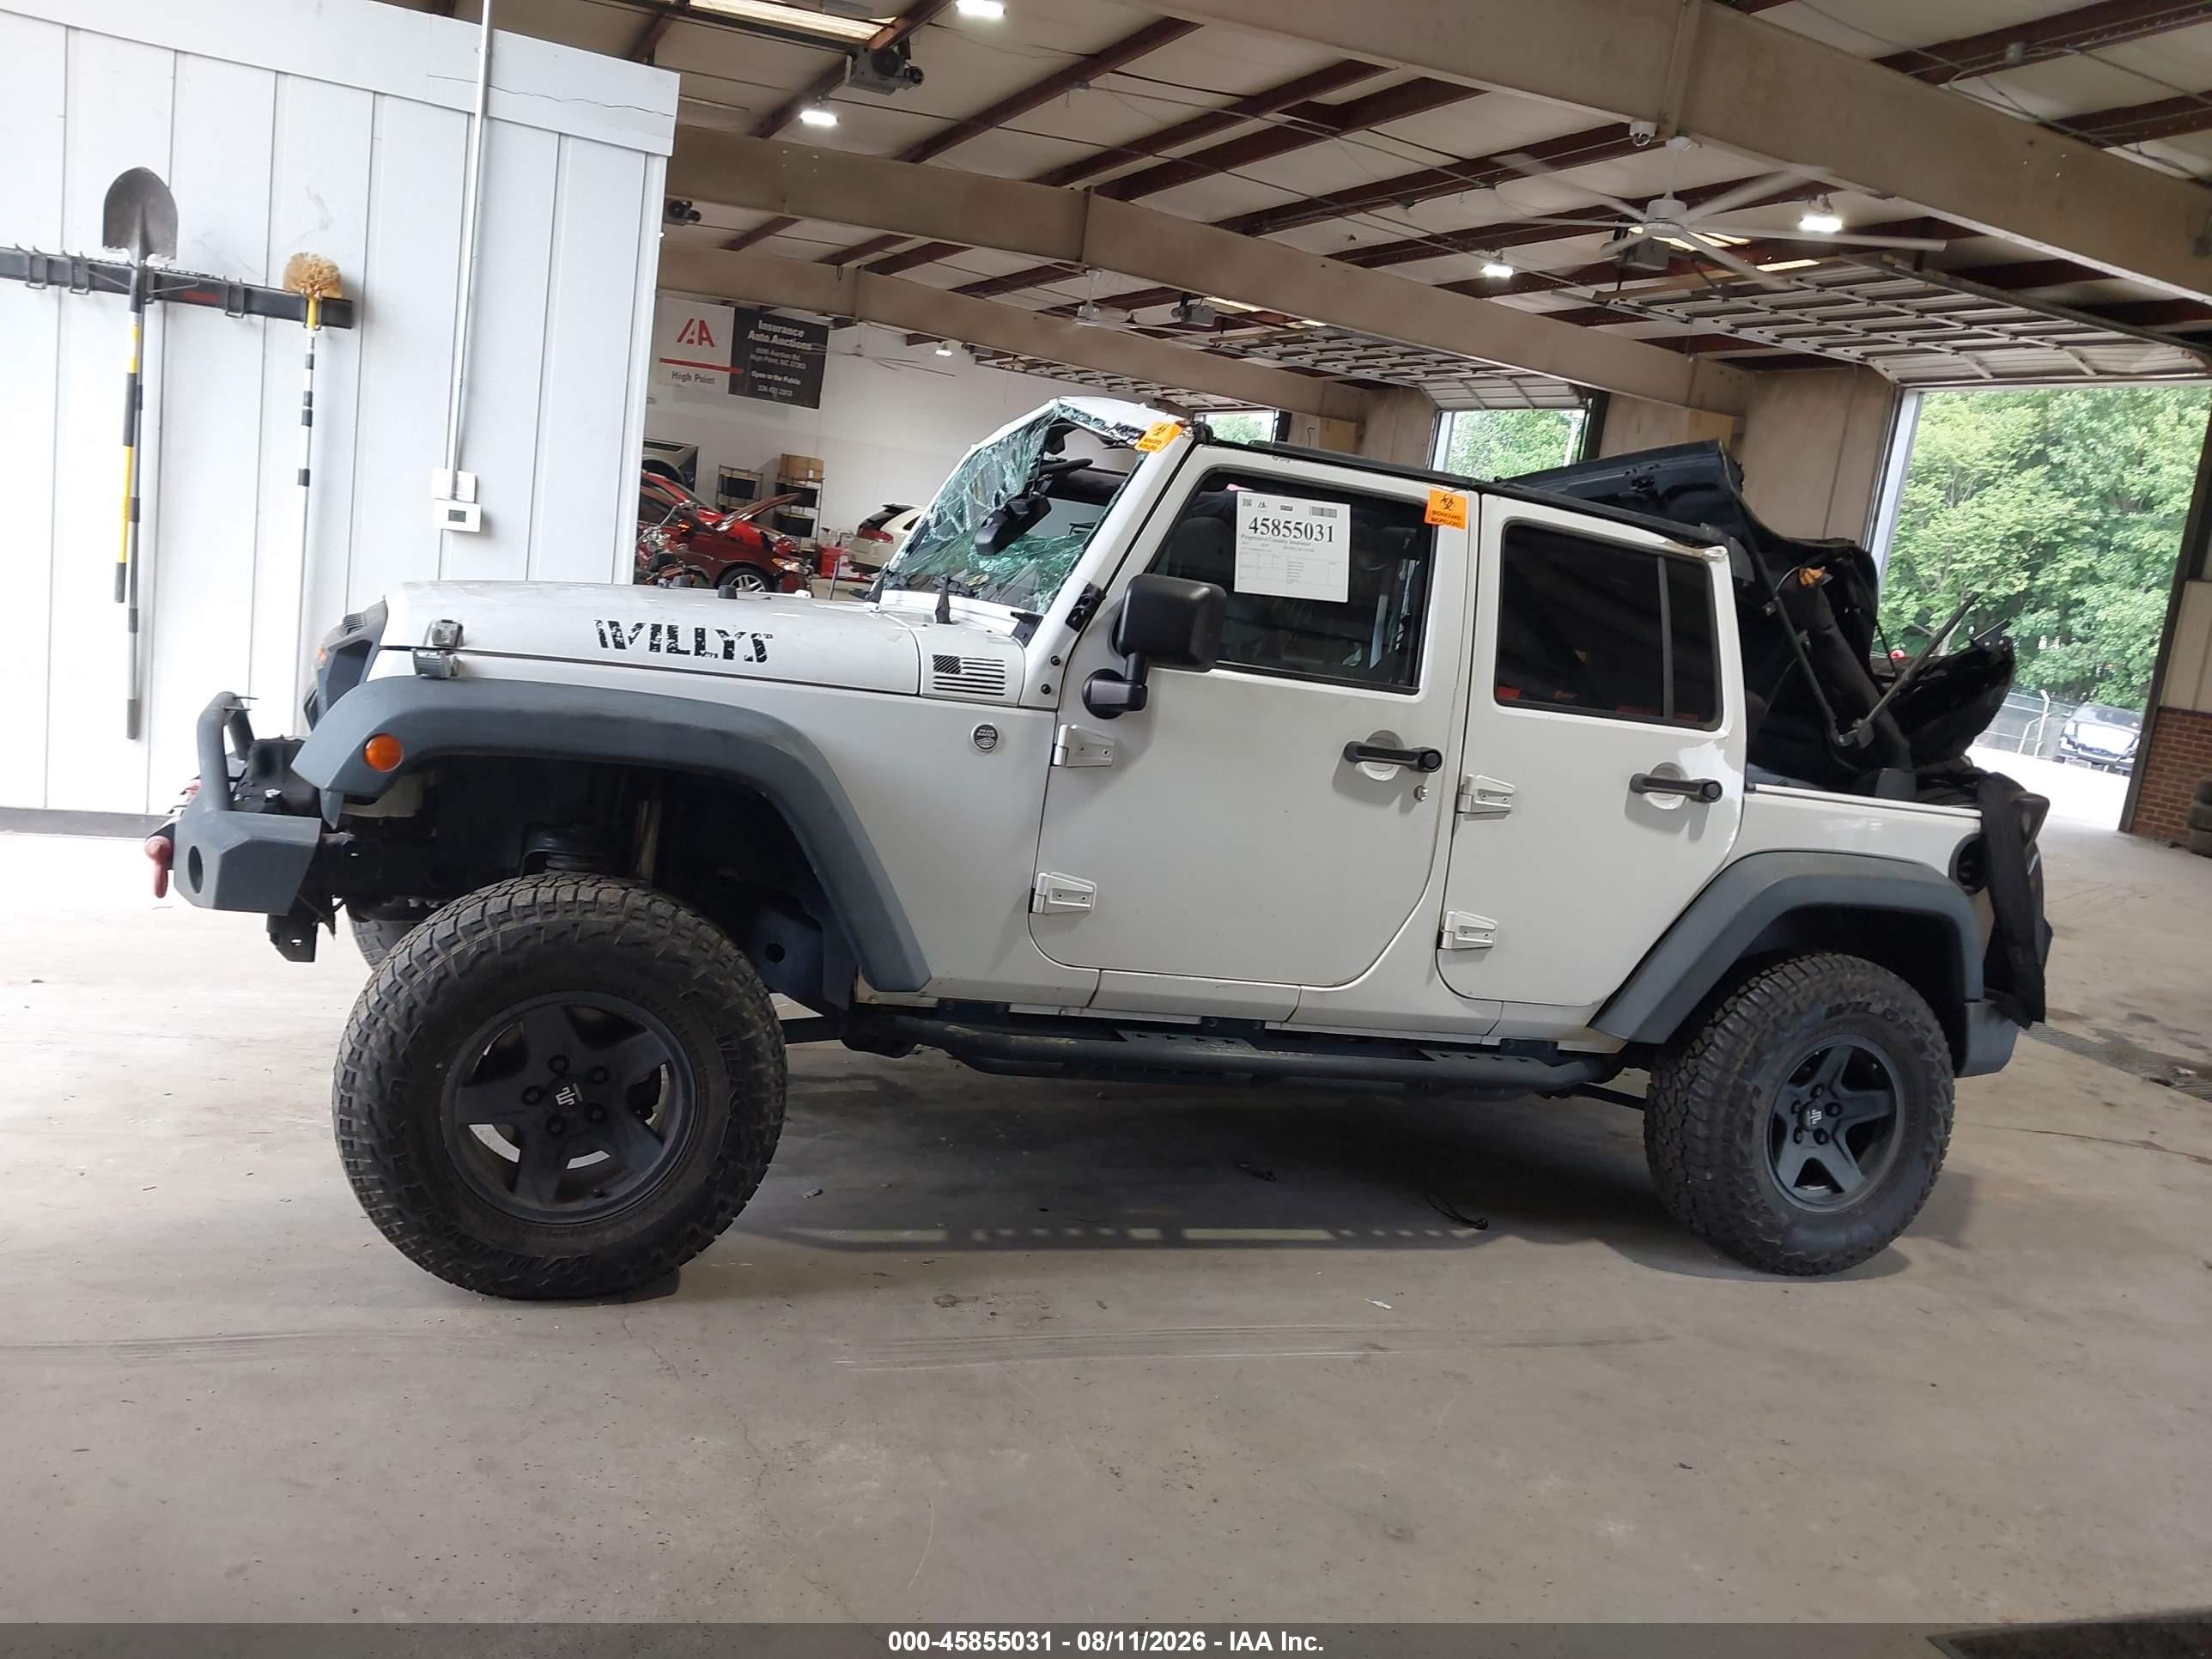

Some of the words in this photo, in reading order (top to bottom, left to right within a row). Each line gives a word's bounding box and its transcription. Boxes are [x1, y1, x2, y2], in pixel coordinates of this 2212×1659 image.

[757, 319, 805, 337] Insurance
[747, 330, 770, 343] Auto
[770, 335, 812, 351] Auctions
[672, 370, 692, 383] High
[694, 373, 714, 385] Point
[750, 370, 767, 380] Open
[782, 375, 801, 385] Public
[1248, 516, 1334, 543] 45855031
[594, 618, 774, 663] WILLYS
